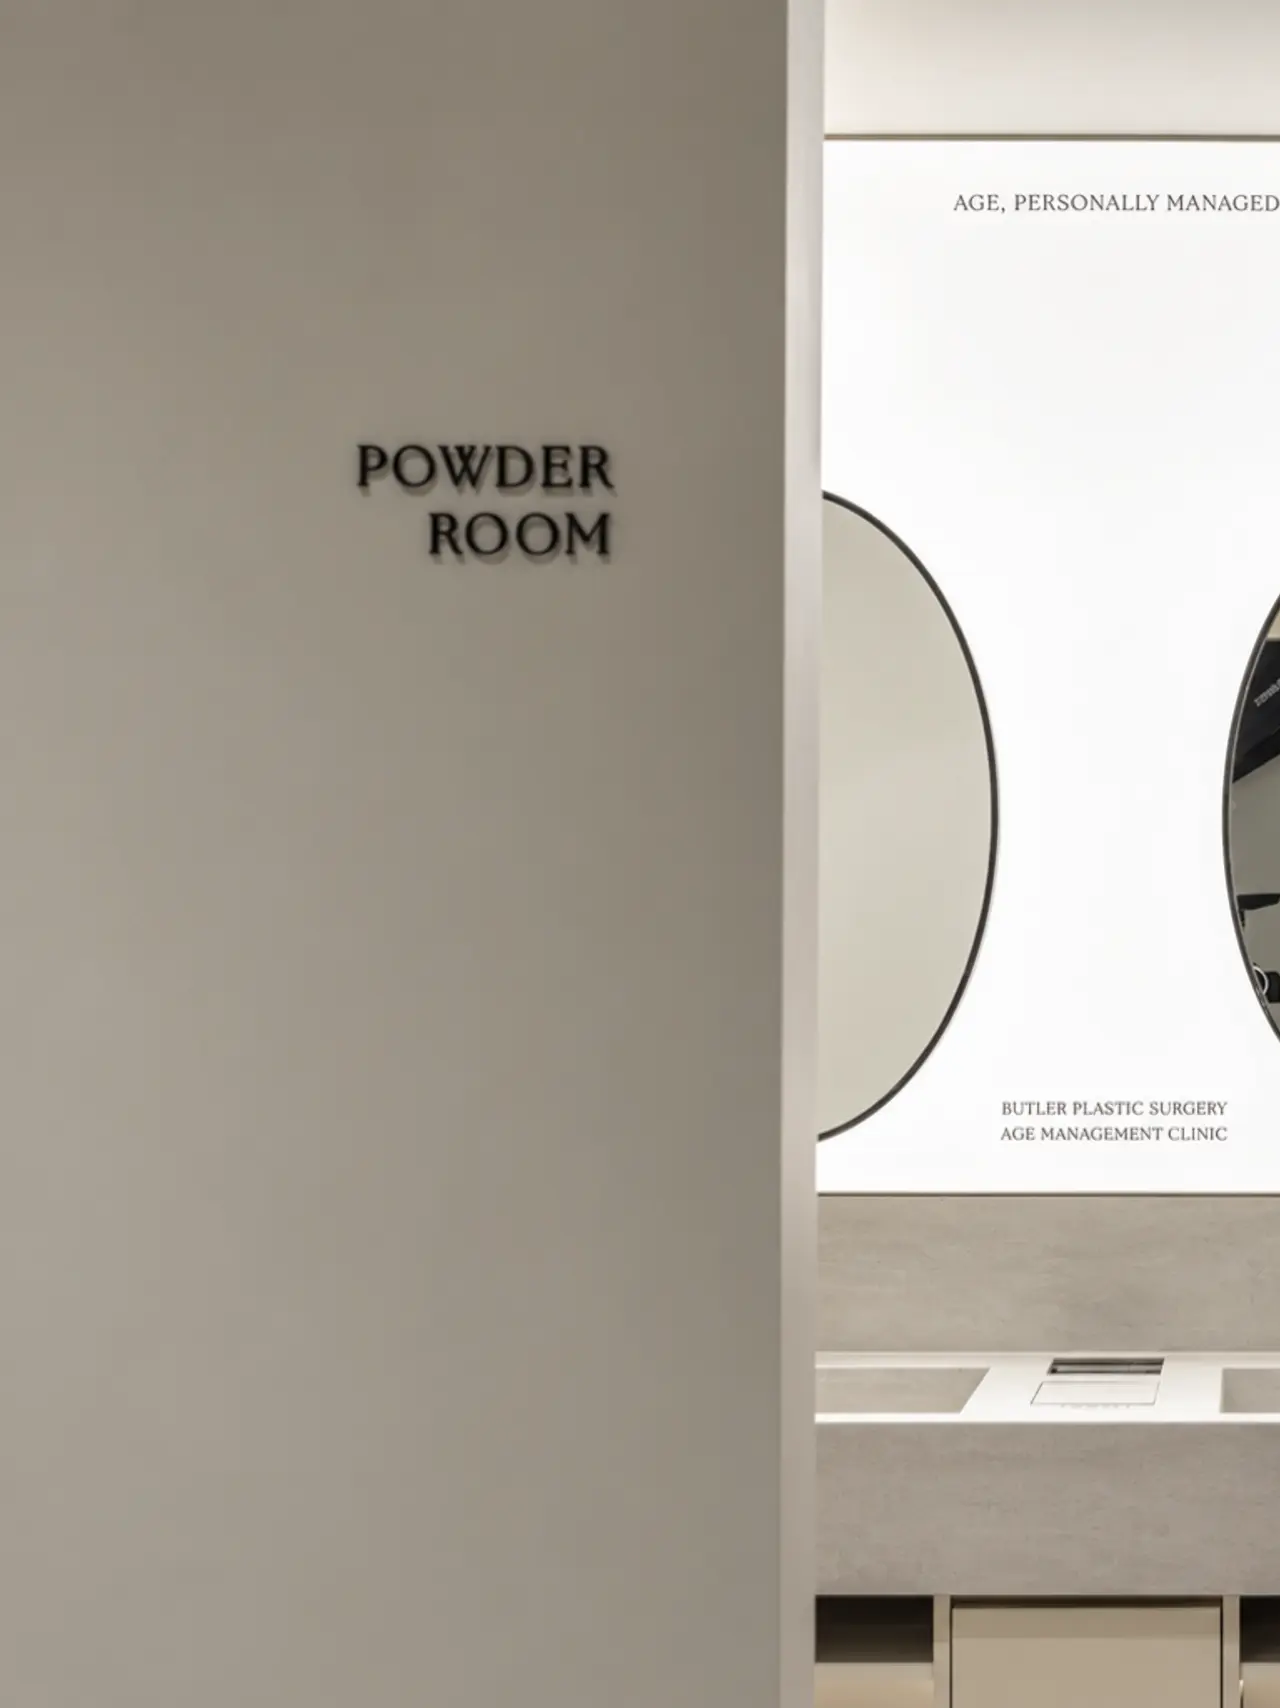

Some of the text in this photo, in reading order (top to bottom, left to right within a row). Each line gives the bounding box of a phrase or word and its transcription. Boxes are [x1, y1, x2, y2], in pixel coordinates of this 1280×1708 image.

[953, 193, 1280, 214] AGE, PERSONALLY MANAGED
[356, 443, 615, 489] POWDER
[428, 511, 611, 556] ROOM
[1001, 1100, 1228, 1117] BUTLER PLASTIC SURGERY
[1000, 1126, 1228, 1142] AGE MANAGEMENT CLINIC
